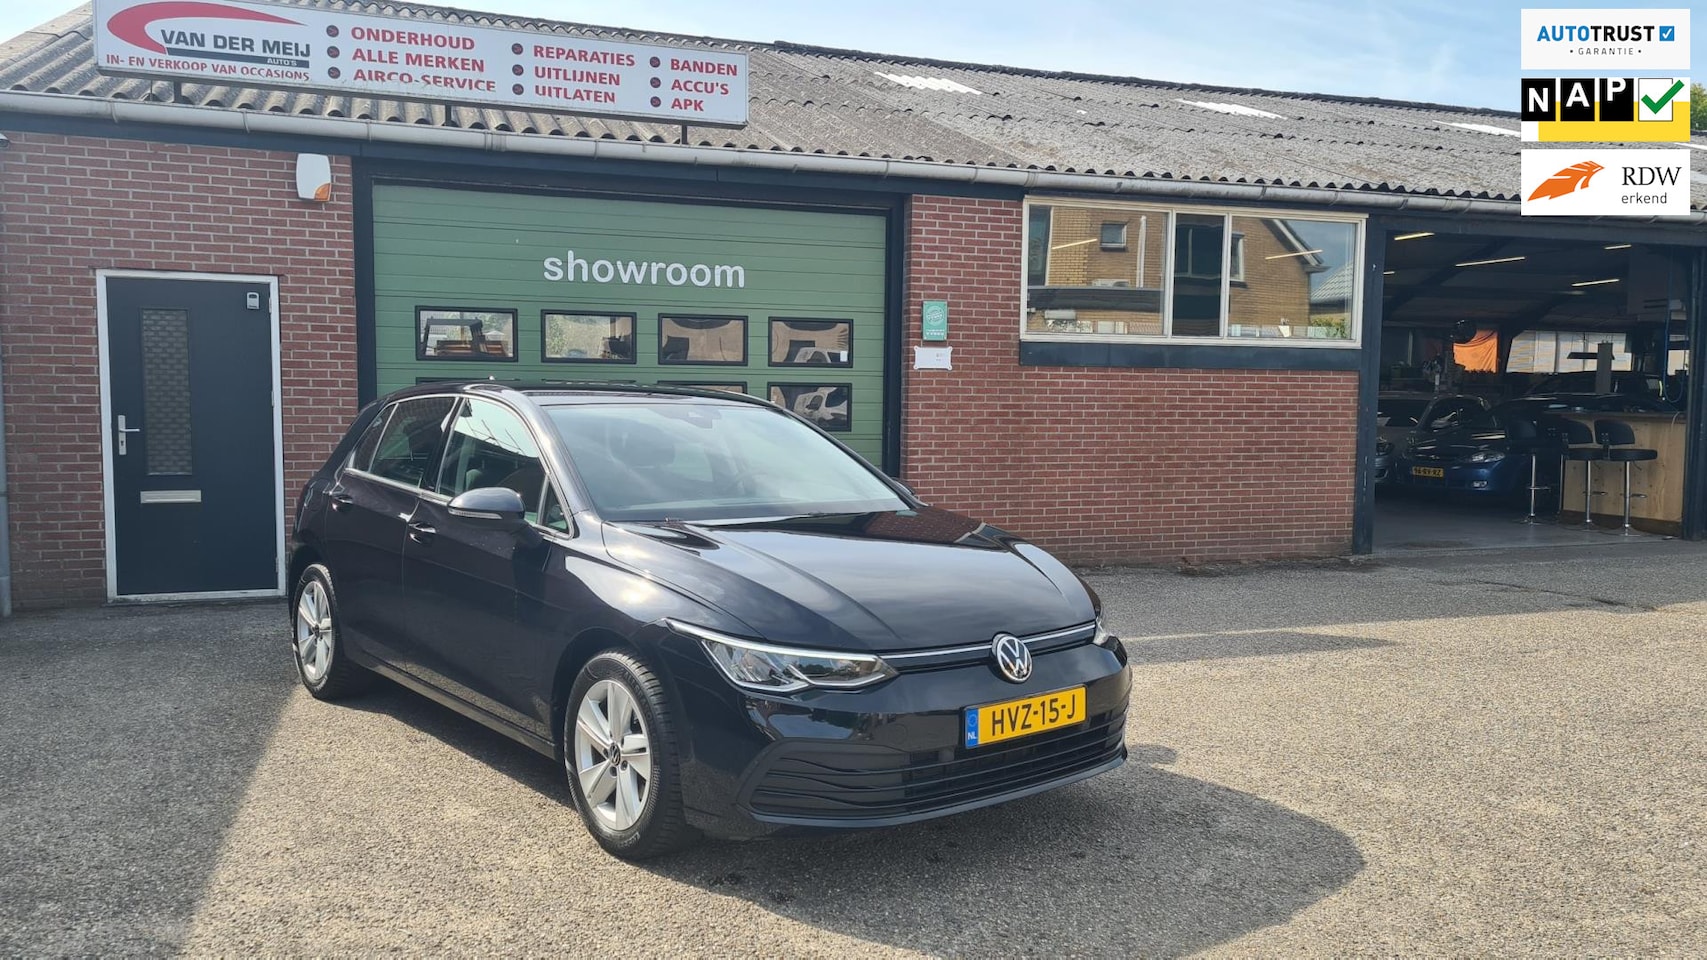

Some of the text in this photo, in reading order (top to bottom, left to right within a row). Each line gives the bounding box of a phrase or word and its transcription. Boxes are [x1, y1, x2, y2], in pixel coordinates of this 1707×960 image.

[160, 29, 311, 58] VAN DER MEIJ
[351, 26, 475, 50] ONDERHOUD
[352, 47, 485, 73] ALLE MERKEN
[533, 45, 635, 67] REPARATIES
[670, 58, 738, 77] BANDEN
[106, 54, 310, 82] IN- EN VERKOOP VAN OCCASIONS
[534, 65, 621, 86] UITLIJNEN
[353, 68, 496, 93] AIRCO-SERVICE
[671, 78, 729, 96] ACCU'S
[535, 84, 616, 104] UITLATEN
[671, 97, 704, 112] APK
[543, 249, 746, 289] showroom
[991, 693, 1076, 737] HVZ-15-J
[967, 731, 977, 740] NL
